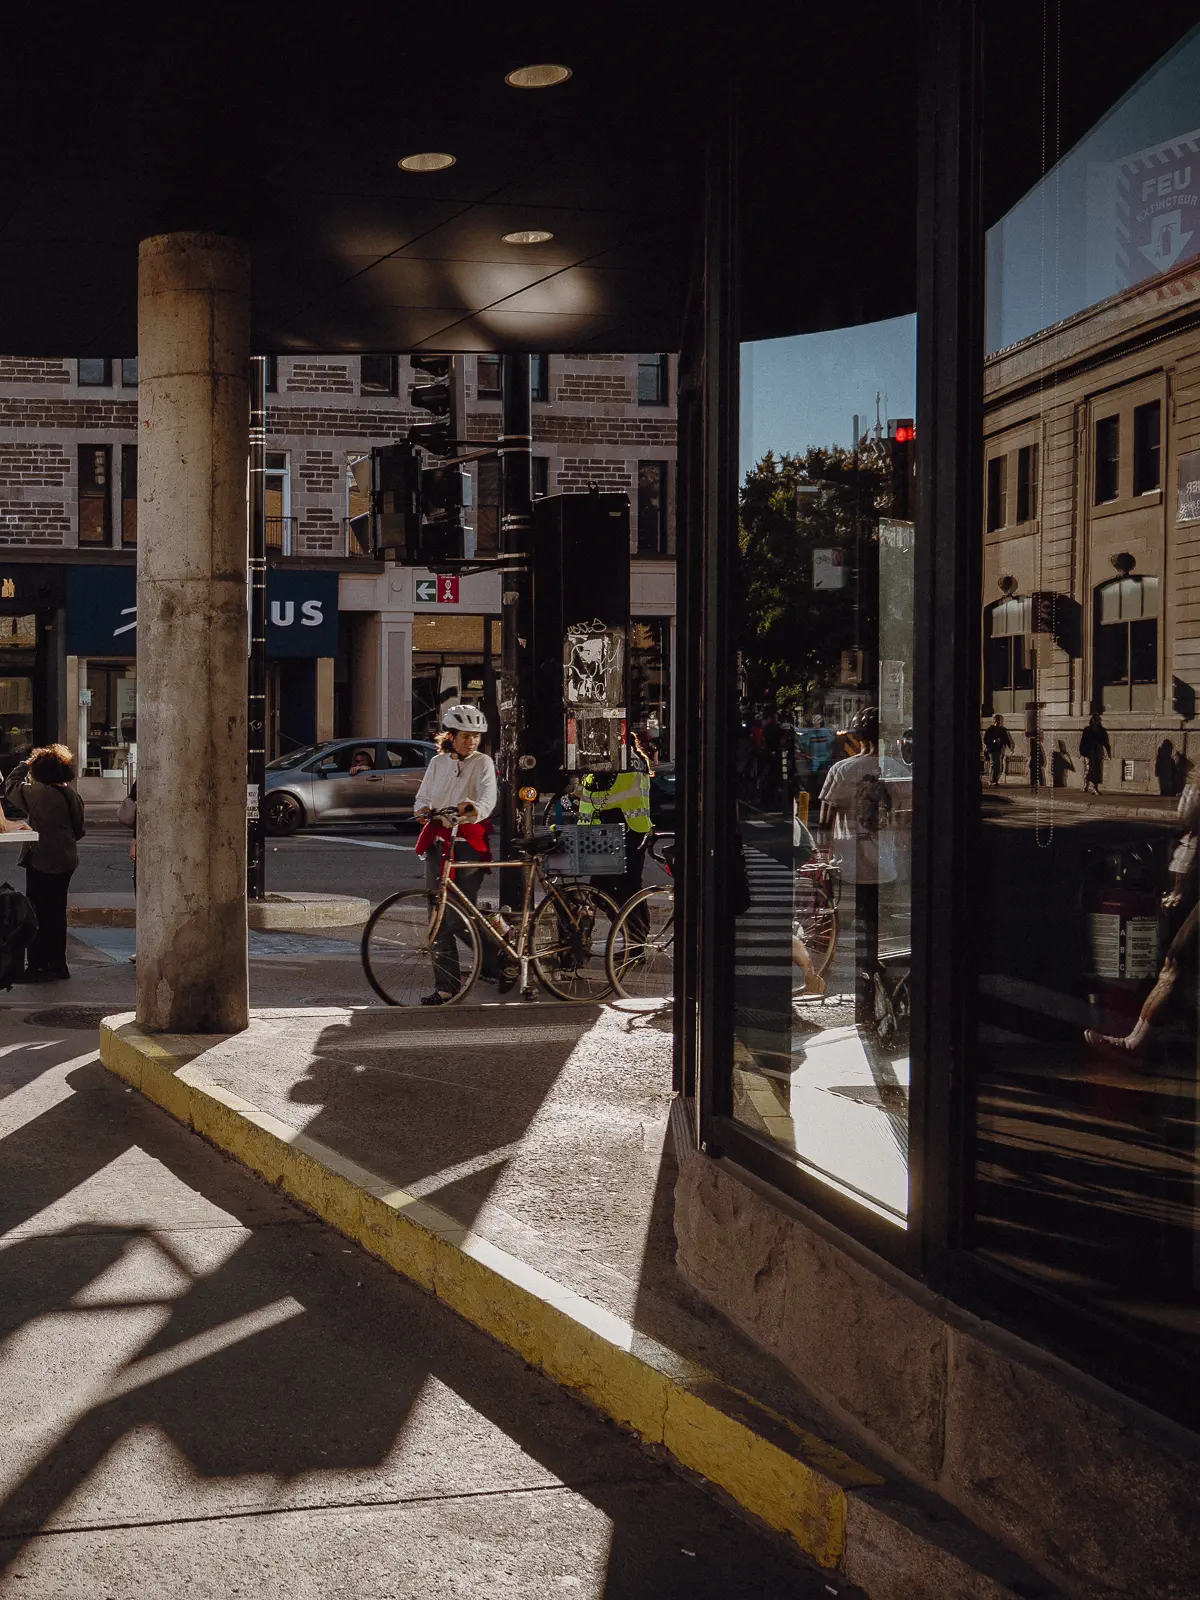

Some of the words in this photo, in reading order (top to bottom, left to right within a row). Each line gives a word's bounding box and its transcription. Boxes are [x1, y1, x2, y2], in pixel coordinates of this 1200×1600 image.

[1142, 166, 1191, 202] FEU
[1136, 194, 1198, 223] EXTINCTEUR
[270, 600, 324, 627] US
